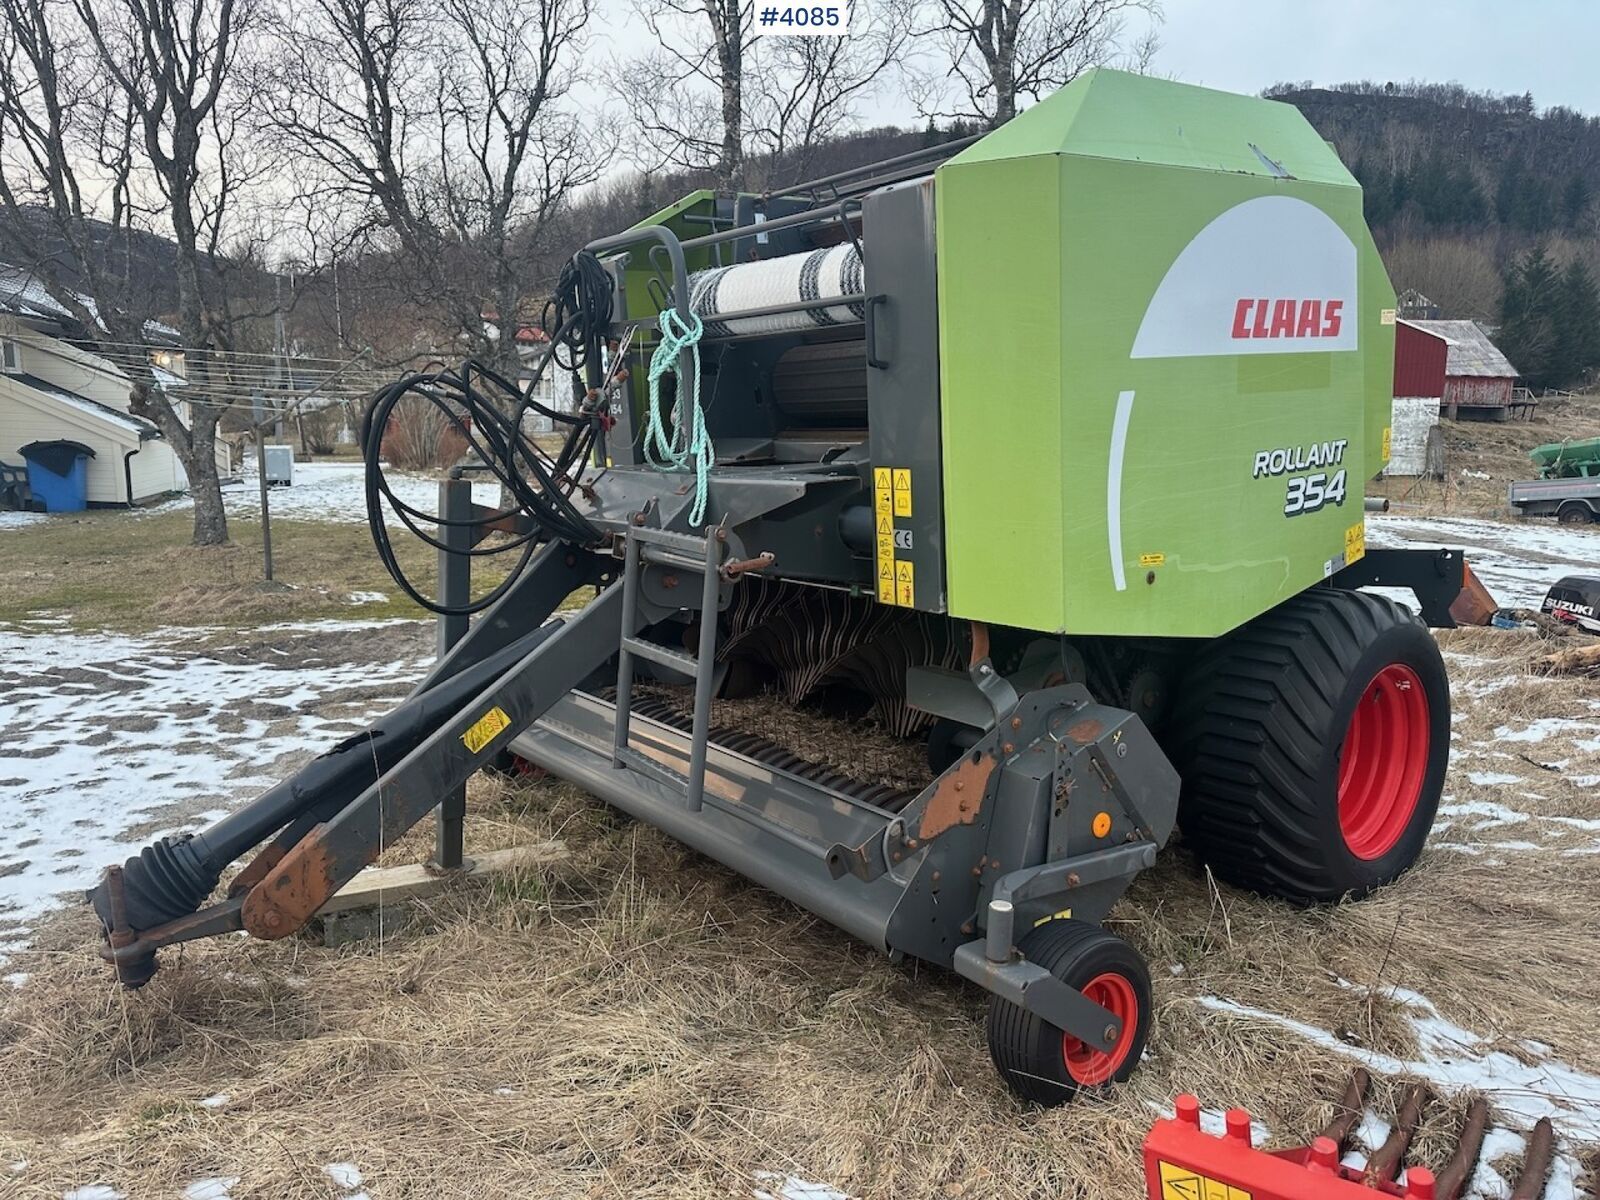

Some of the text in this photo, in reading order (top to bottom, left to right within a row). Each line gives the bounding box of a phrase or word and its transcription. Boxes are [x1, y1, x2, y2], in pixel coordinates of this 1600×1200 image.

[1232, 299, 1343, 338] CLAAS
[1253, 439, 1348, 479] ROLLANT
[1284, 469, 1346, 518] 354
[1545, 597, 1594, 616] SUZUKI
